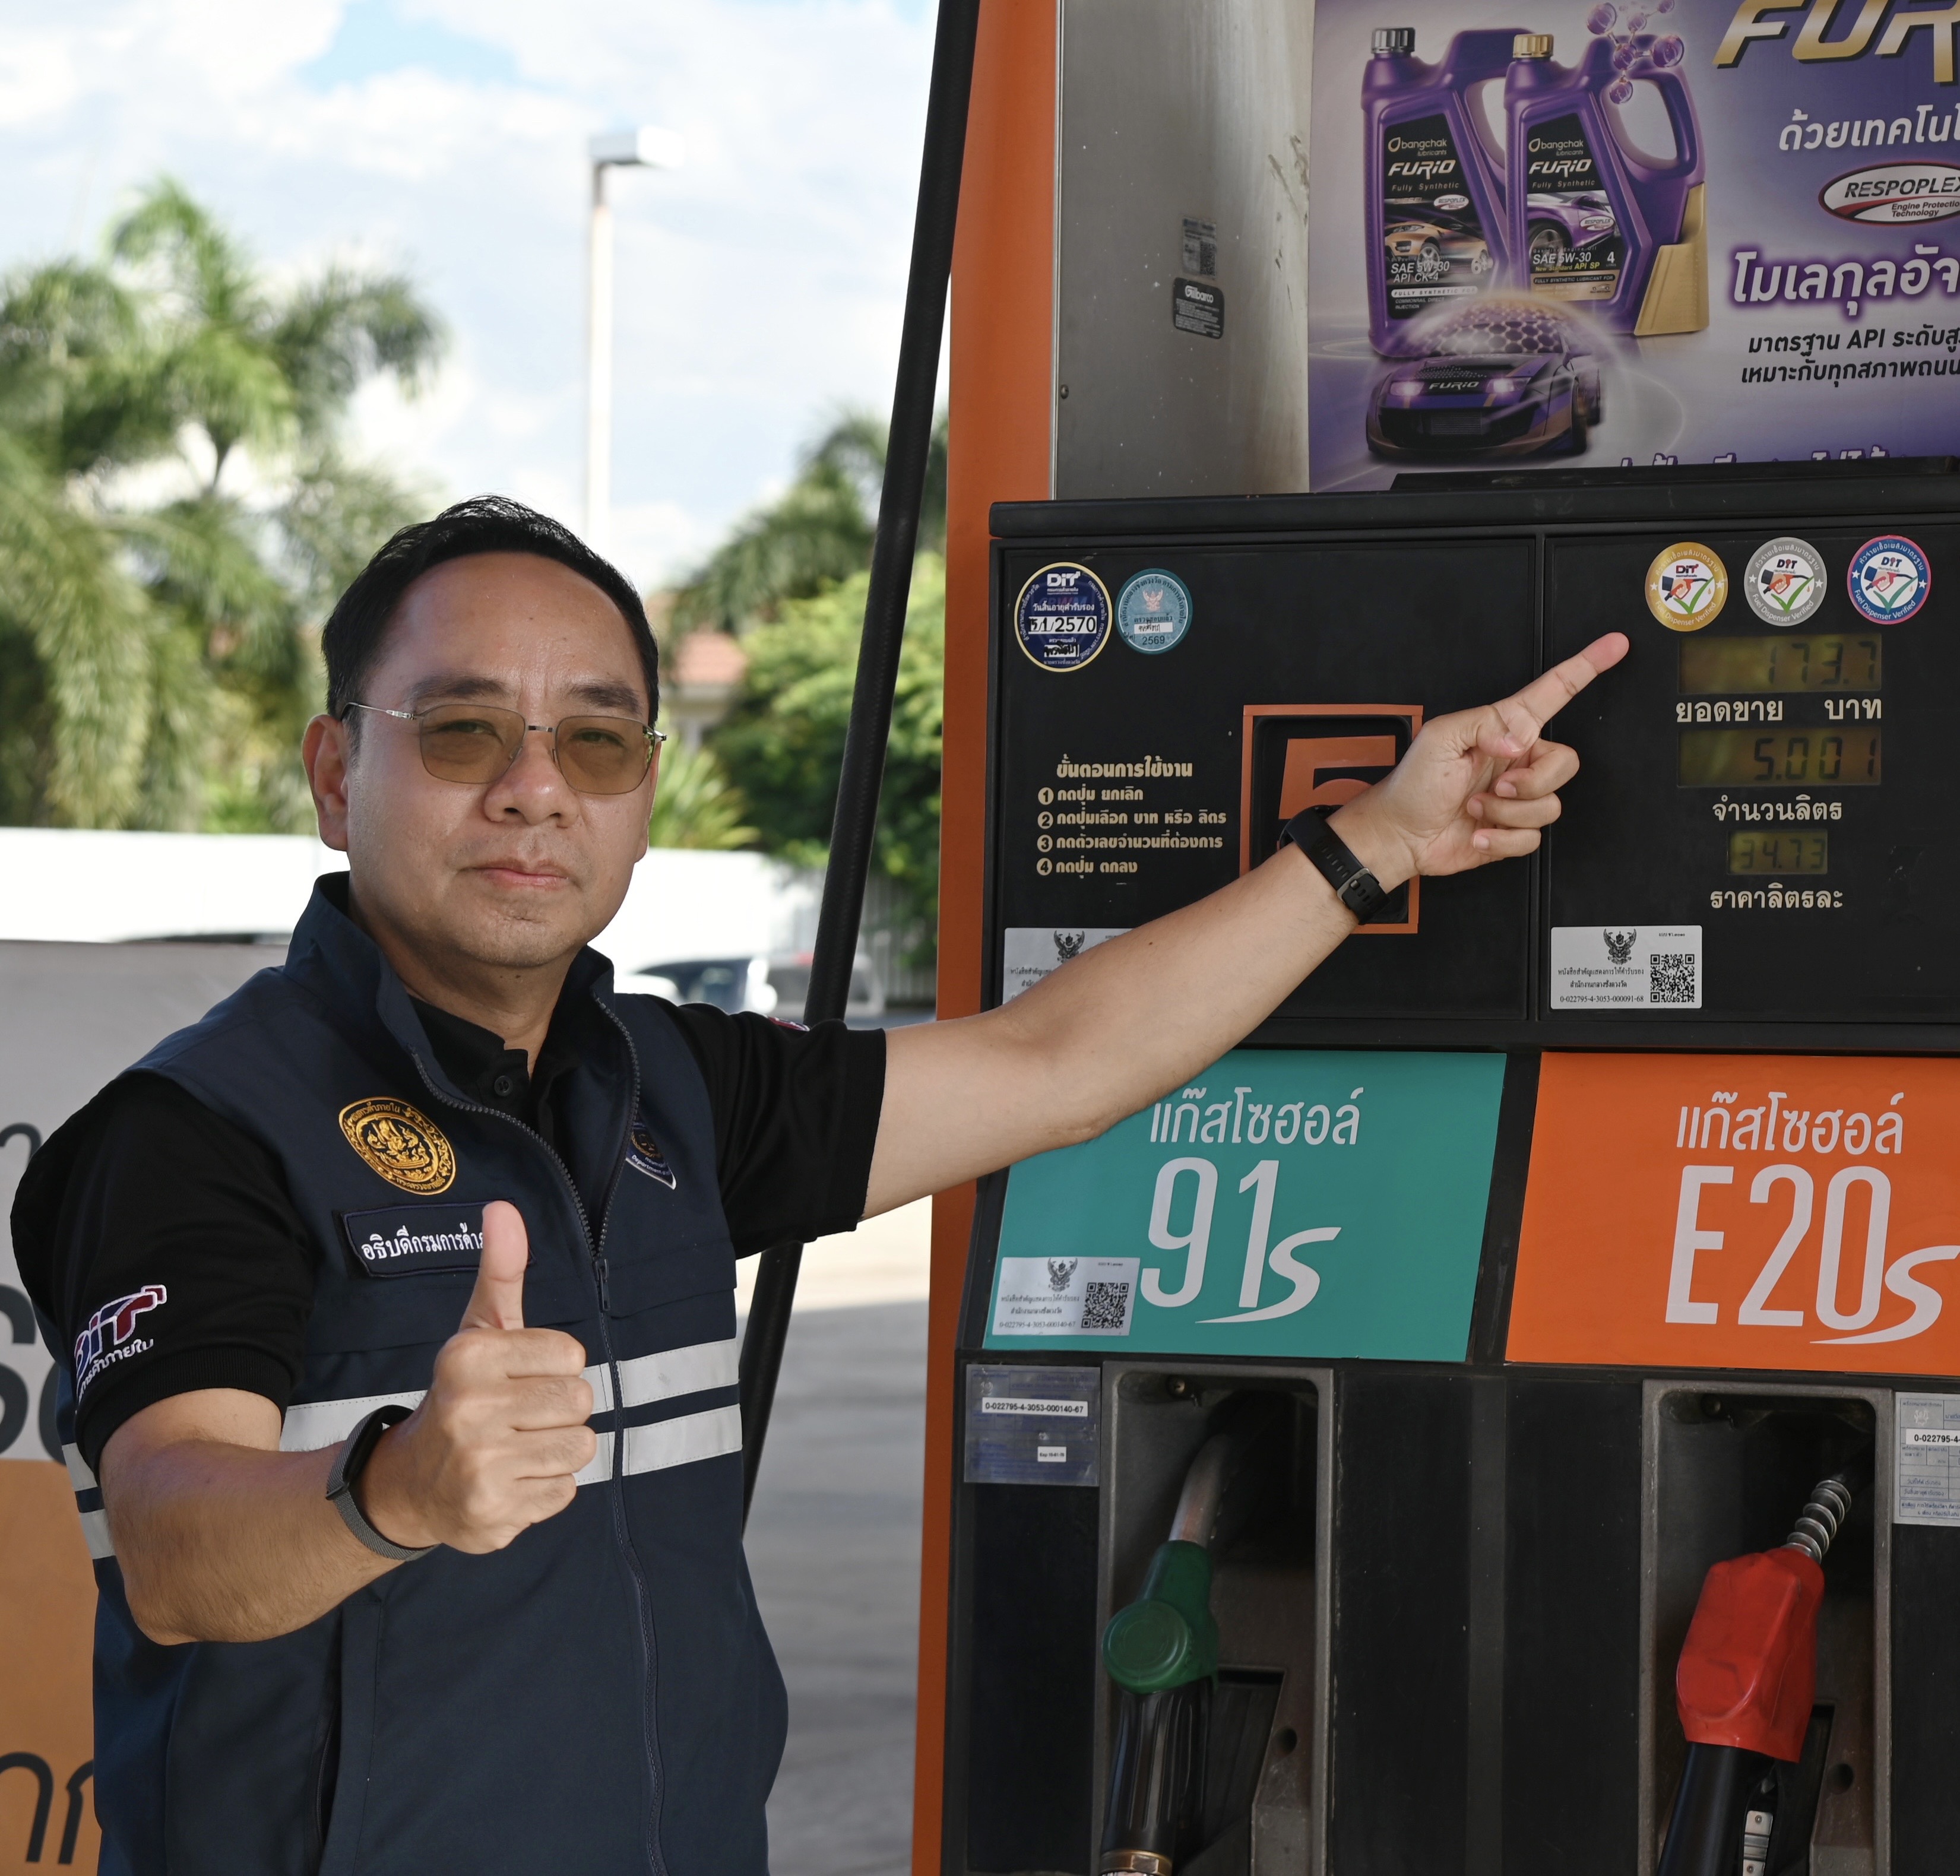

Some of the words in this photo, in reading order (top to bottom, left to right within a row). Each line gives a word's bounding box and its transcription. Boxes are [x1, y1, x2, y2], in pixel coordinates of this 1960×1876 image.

[1402, 138, 1447, 150] bangchak
[1541, 140, 1584, 150] bangchak
[1419, 182, 1459, 191] Synthetic
[1558, 179, 1595, 188] Synthetic
[1892, 202, 1920, 212] Engine
[1892, 209, 1939, 218] Technology
[1391, 262, 1414, 274] SAE
[1417, 261, 1450, 272] 5W-30
[1533, 253, 1556, 265] SAE
[1559, 252, 1592, 263] 5W-30
[1607, 251, 1615, 264] 4
[1394, 273, 1410, 283] API
[1414, 272, 1439, 282] CK-4
[1749, 333, 1840, 356] มาตรฐาน
[1847, 328, 1885, 349] API
[1892, 324, 1960, 353] ระดับสู
[1655, 601, 1667, 615] Fuel
[1665, 613, 1695, 626] Dispenser
[1695, 602, 1717, 622] Verified
[1752, 593, 1763, 607] Fuel
[1761, 606, 1790, 622] Dispenser
[1791, 600, 1815, 620] Verified
[1854, 590, 1866, 605] Fuel
[1862, 603, 1892, 620] Dispenser
[1892, 600, 1916, 619] Verified
[1142, 635, 1165, 645] 2569
[1768, 641, 1877, 685] 173.7
[1676, 700, 1783, 722] ยอดขาย
[1824, 698, 1882, 720] บาท
[1056, 753, 1193, 778] ขั้นตอนการใช้งาน
[1754, 737, 1876, 781] 5.001
[1057, 784, 1095, 806] กดปุ่ม
[1101, 786, 1144, 800] ยกเลิก
[1057, 807, 1128, 829] กดปุ่มเลือก
[1134, 813, 1158, 824] บาท
[1164, 809, 1193, 824] หรือ
[1198, 809, 1227, 824] ลิตร
[1712, 794, 1842, 821] จำนวนลิตร
[1056, 829, 1223, 848] กดตัวเลขจำนวนที่ต้องการ
[1740, 839, 1825, 869] 34.73
[1056, 855, 1094, 879] กดปุ่ม
[1100, 861, 1138, 873] ตกลง
[1710, 882, 1843, 909] ราคาลิตรละ
[1150, 1087, 1363, 1145] แก๊สโซฮอล์
[1676, 1091, 1904, 1155] แก๊สโซฮอล์
[986, 1402, 1084, 1413] 0-022795-4-3053-000140-67
